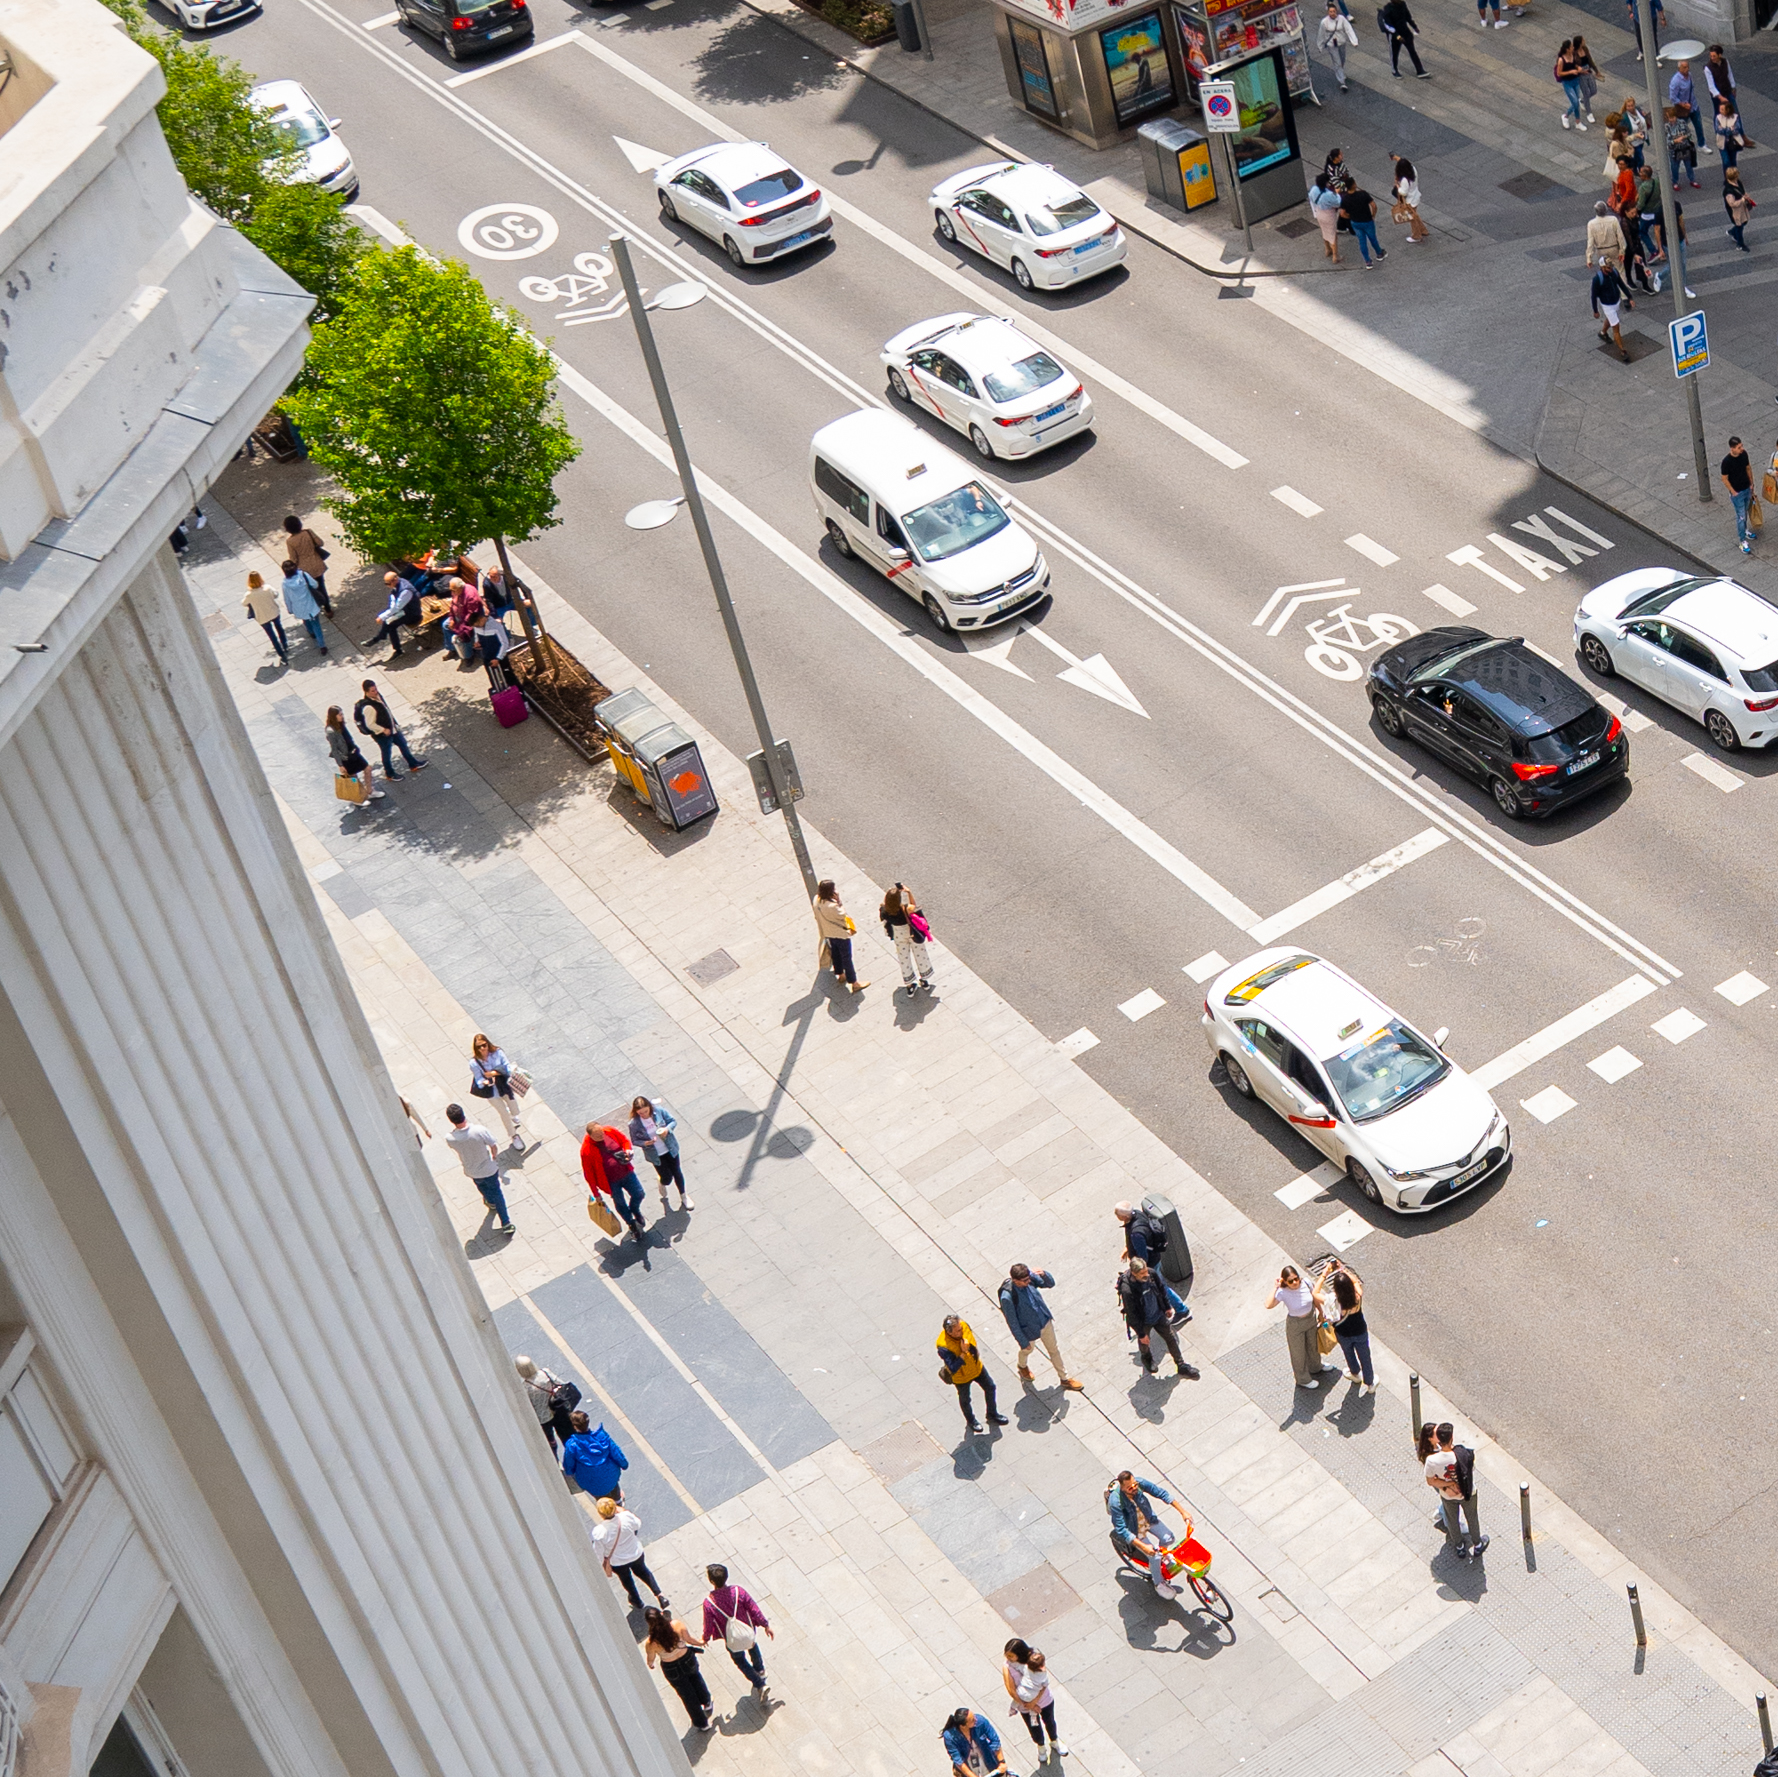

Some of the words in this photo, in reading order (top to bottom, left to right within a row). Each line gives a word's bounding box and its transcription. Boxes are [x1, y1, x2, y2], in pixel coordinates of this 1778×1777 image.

[479, 214, 540, 250] 30
[1674, 317, 1701, 357] P
[1445, 505, 1616, 595] TAXI
